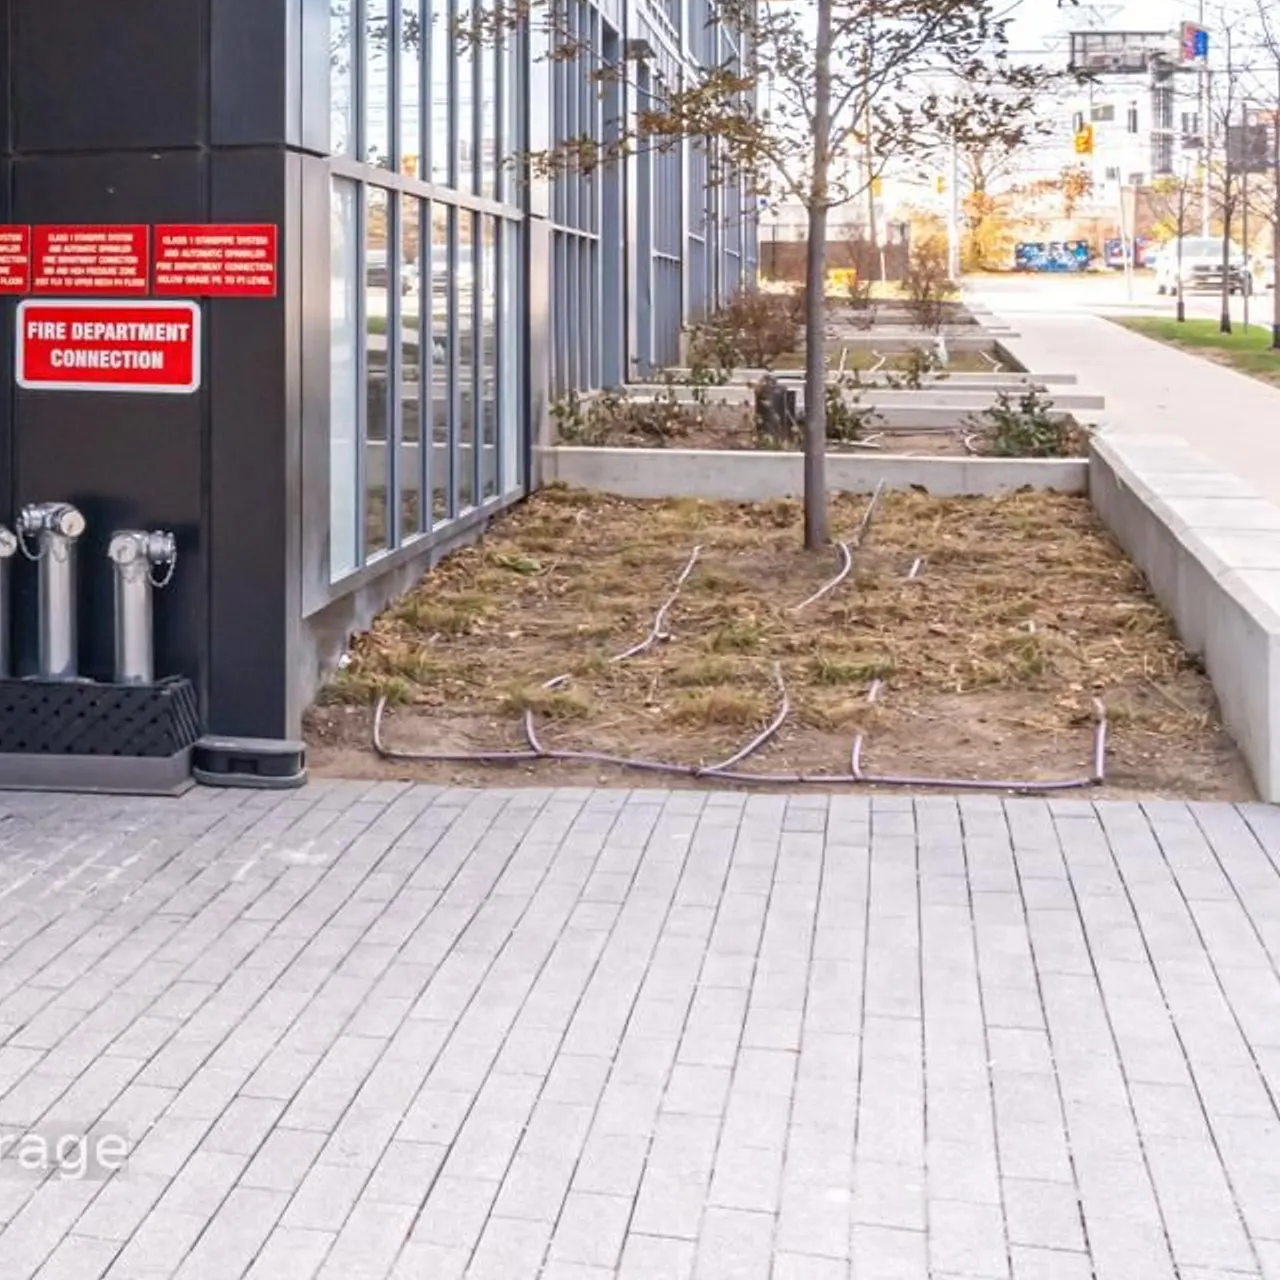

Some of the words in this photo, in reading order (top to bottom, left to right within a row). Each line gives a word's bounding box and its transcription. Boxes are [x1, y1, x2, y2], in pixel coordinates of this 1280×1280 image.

[27, 322, 67, 340] FIRE
[72, 322, 190, 342] DEPARTMENT
[50, 349, 164, 369] CONNECTION
